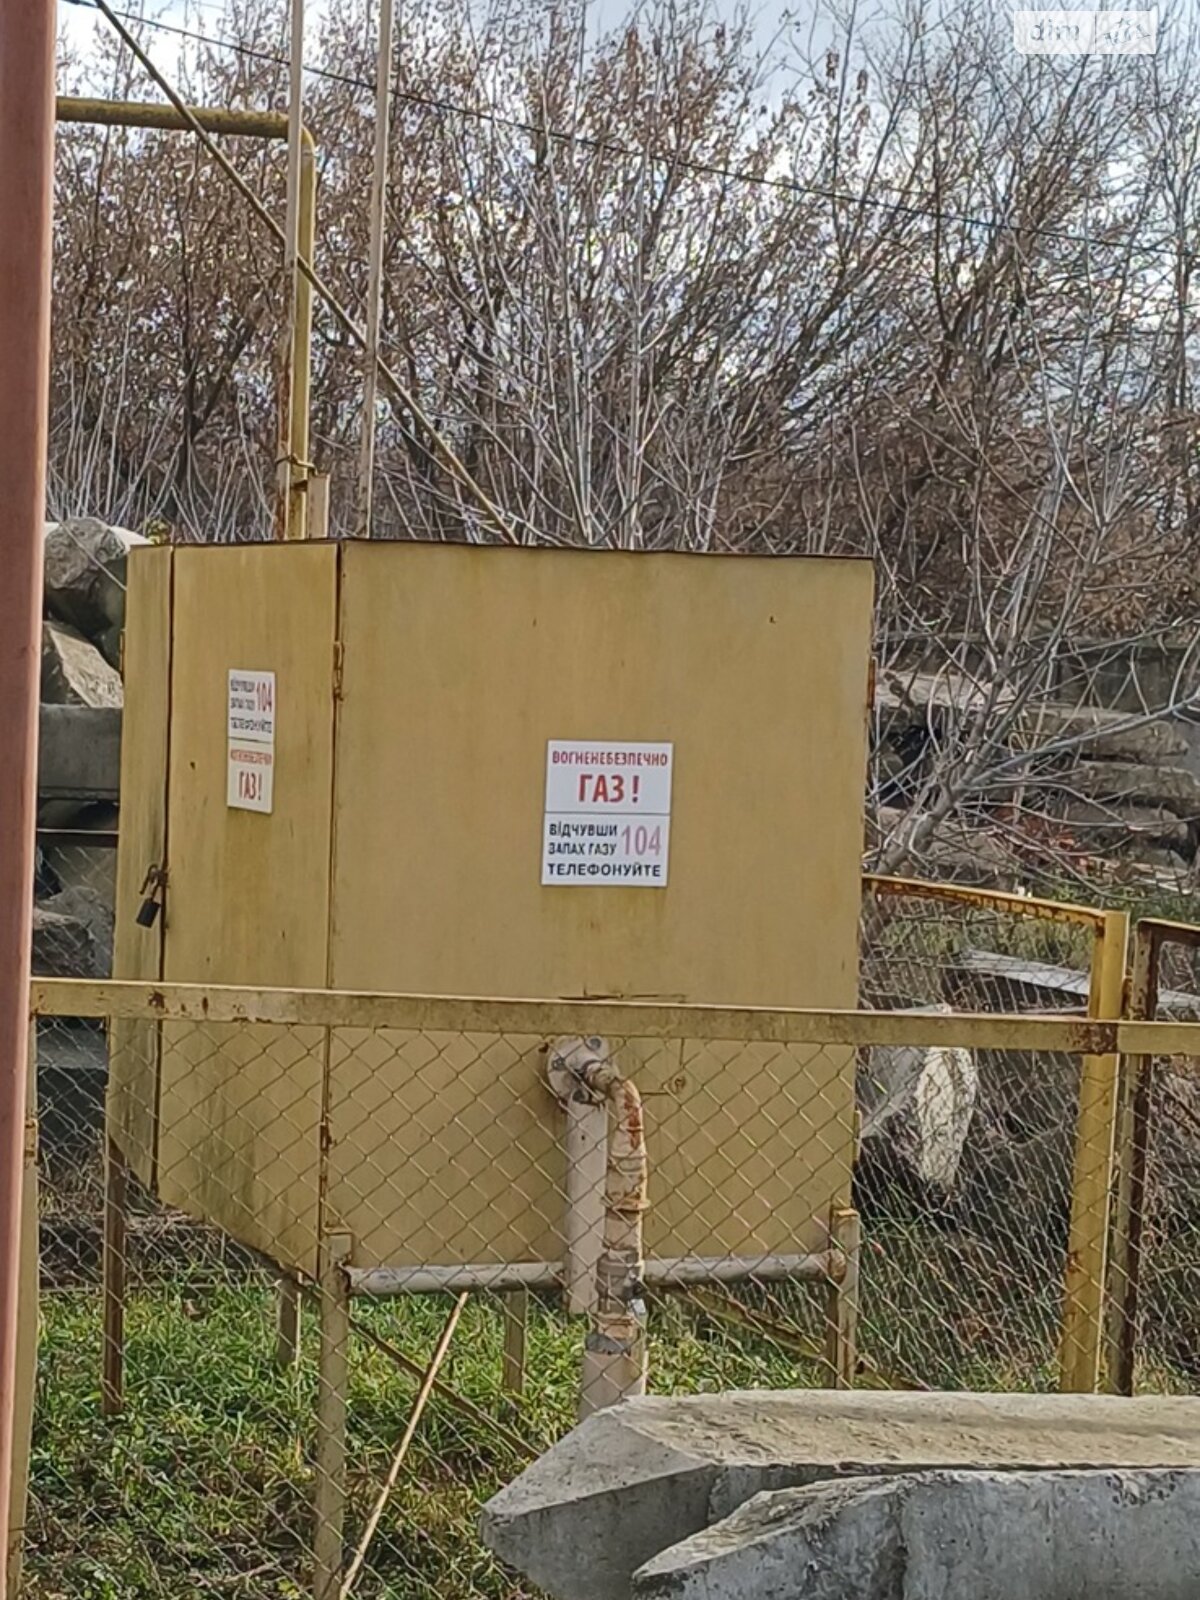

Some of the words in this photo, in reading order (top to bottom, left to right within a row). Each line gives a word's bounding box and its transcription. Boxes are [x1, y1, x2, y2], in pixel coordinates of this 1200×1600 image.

[256, 681, 272, 712] 104
[552, 750, 668, 766] ВОГНЕНЕБЕЗПЕЧНО
[549, 821, 618, 838] ВІДЧУВШИ
[621, 825, 662, 856] 104
[548, 842, 586, 855] ЗАПАХ
[588, 843, 617, 856] ГАЗУ
[548, 862, 661, 877] ТЕЛЕФОНУЙТЕ
